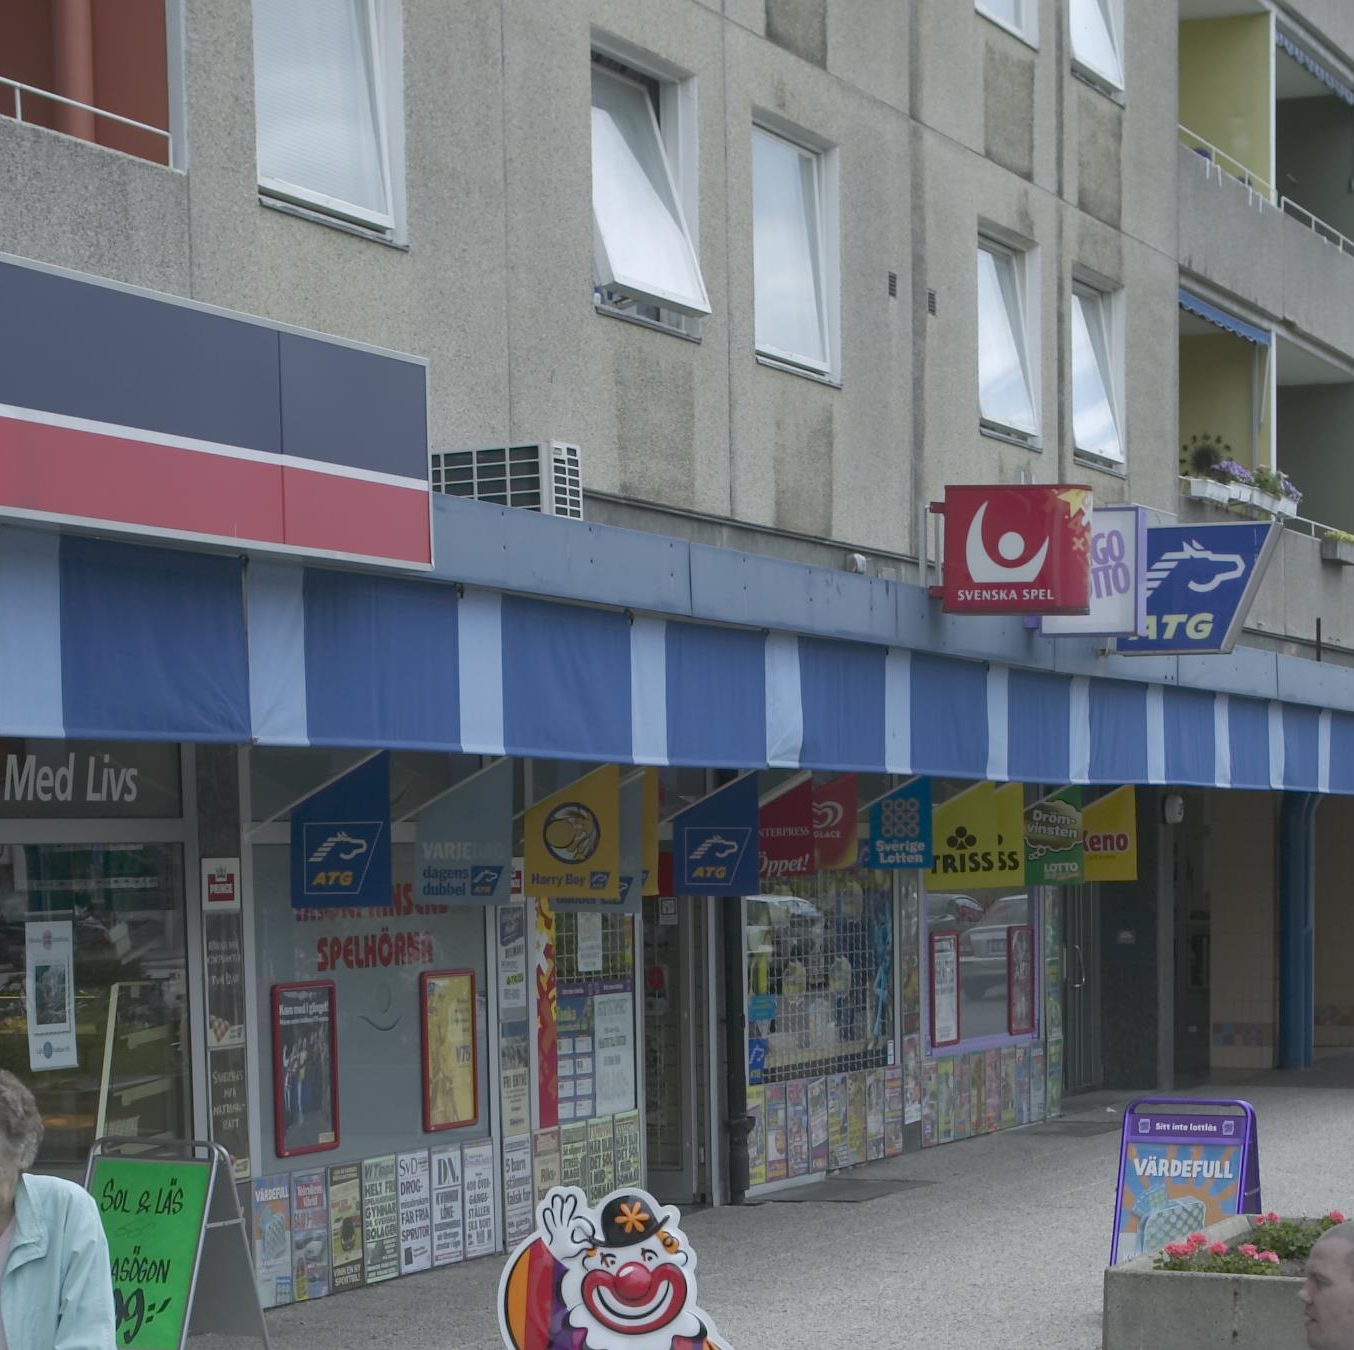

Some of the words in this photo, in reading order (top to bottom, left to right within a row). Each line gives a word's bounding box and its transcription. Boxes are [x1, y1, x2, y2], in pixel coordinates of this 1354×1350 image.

[1091, 561, 1130, 599] TTO
[957, 588, 1017, 601] SVENSKA
[1022, 588, 1055, 601] SPEL
[1129, 613, 1214, 641] ATG
[3, 753, 76, 802] Med
[86, 754, 139, 802] Livs
[1032, 809, 1077, 825] Dröm-
[758, 826, 810, 839] NTERPRESS
[1027, 823, 1078, 839] vinsten
[875, 839, 926, 853] Sverige
[879, 853, 924, 864] Lotten
[931, 851, 994, 875] TRISS
[422, 865, 469, 881] dagens
[692, 866, 727, 880] ATG
[1044, 862, 1079, 873] LOTTO
[312, 872, 354, 886] ATG
[531, 872, 562, 887] Harry
[565, 872, 586, 887] Boy
[422, 881, 466, 897] dubbel
[1155, 1122, 1171, 1131] Sitt
[1172, 1122, 1189, 1132] inte
[399, 1158, 418, 1177] SvD
[1133, 1156, 1234, 1179] VÄRDEFULL
[400, 1179, 423, 1196] DROG-
[101, 1178, 130, 1213] SOL
[136, 1190, 151, 1215] &
[155, 1178, 184, 1216] LÄS
[111, 1245, 171, 1284] ASÖGON
